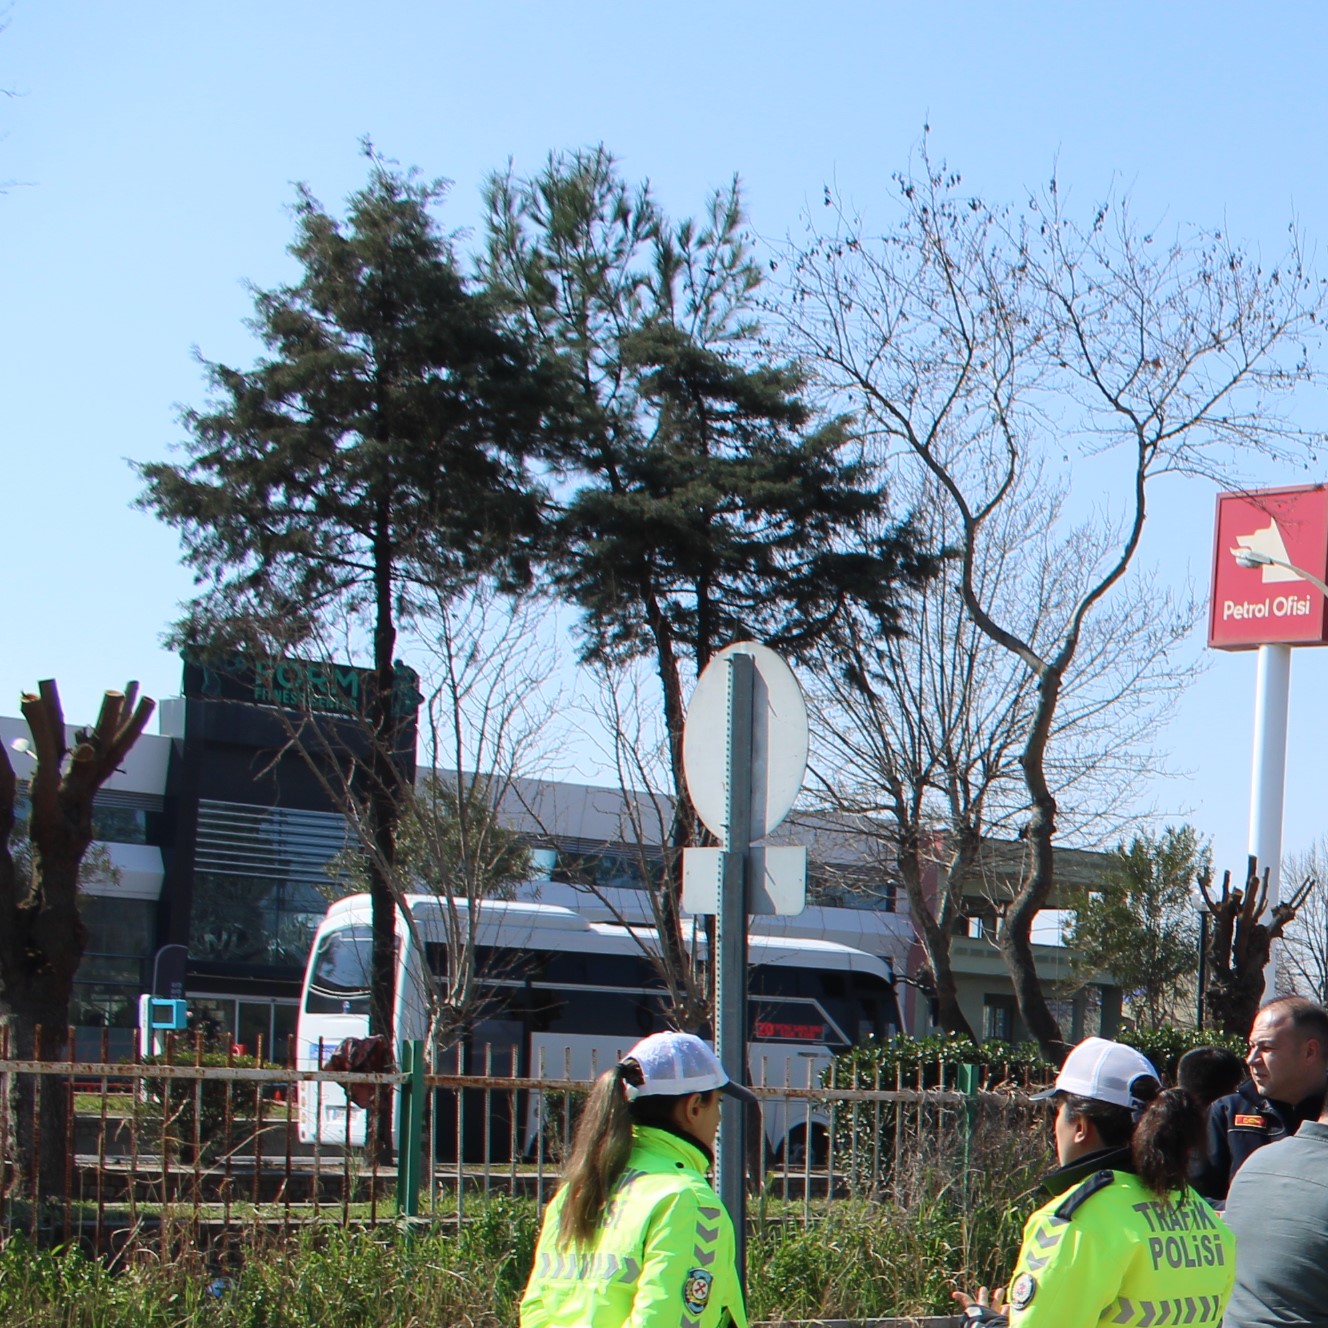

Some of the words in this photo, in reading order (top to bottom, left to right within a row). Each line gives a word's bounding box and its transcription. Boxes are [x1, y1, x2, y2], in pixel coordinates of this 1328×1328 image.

[1223, 598, 1270, 620] Petrol
[1272, 594, 1311, 617] Ofisi
[255, 662, 359, 698] FORM
[1148, 1234, 1225, 1271] POLİSİ
